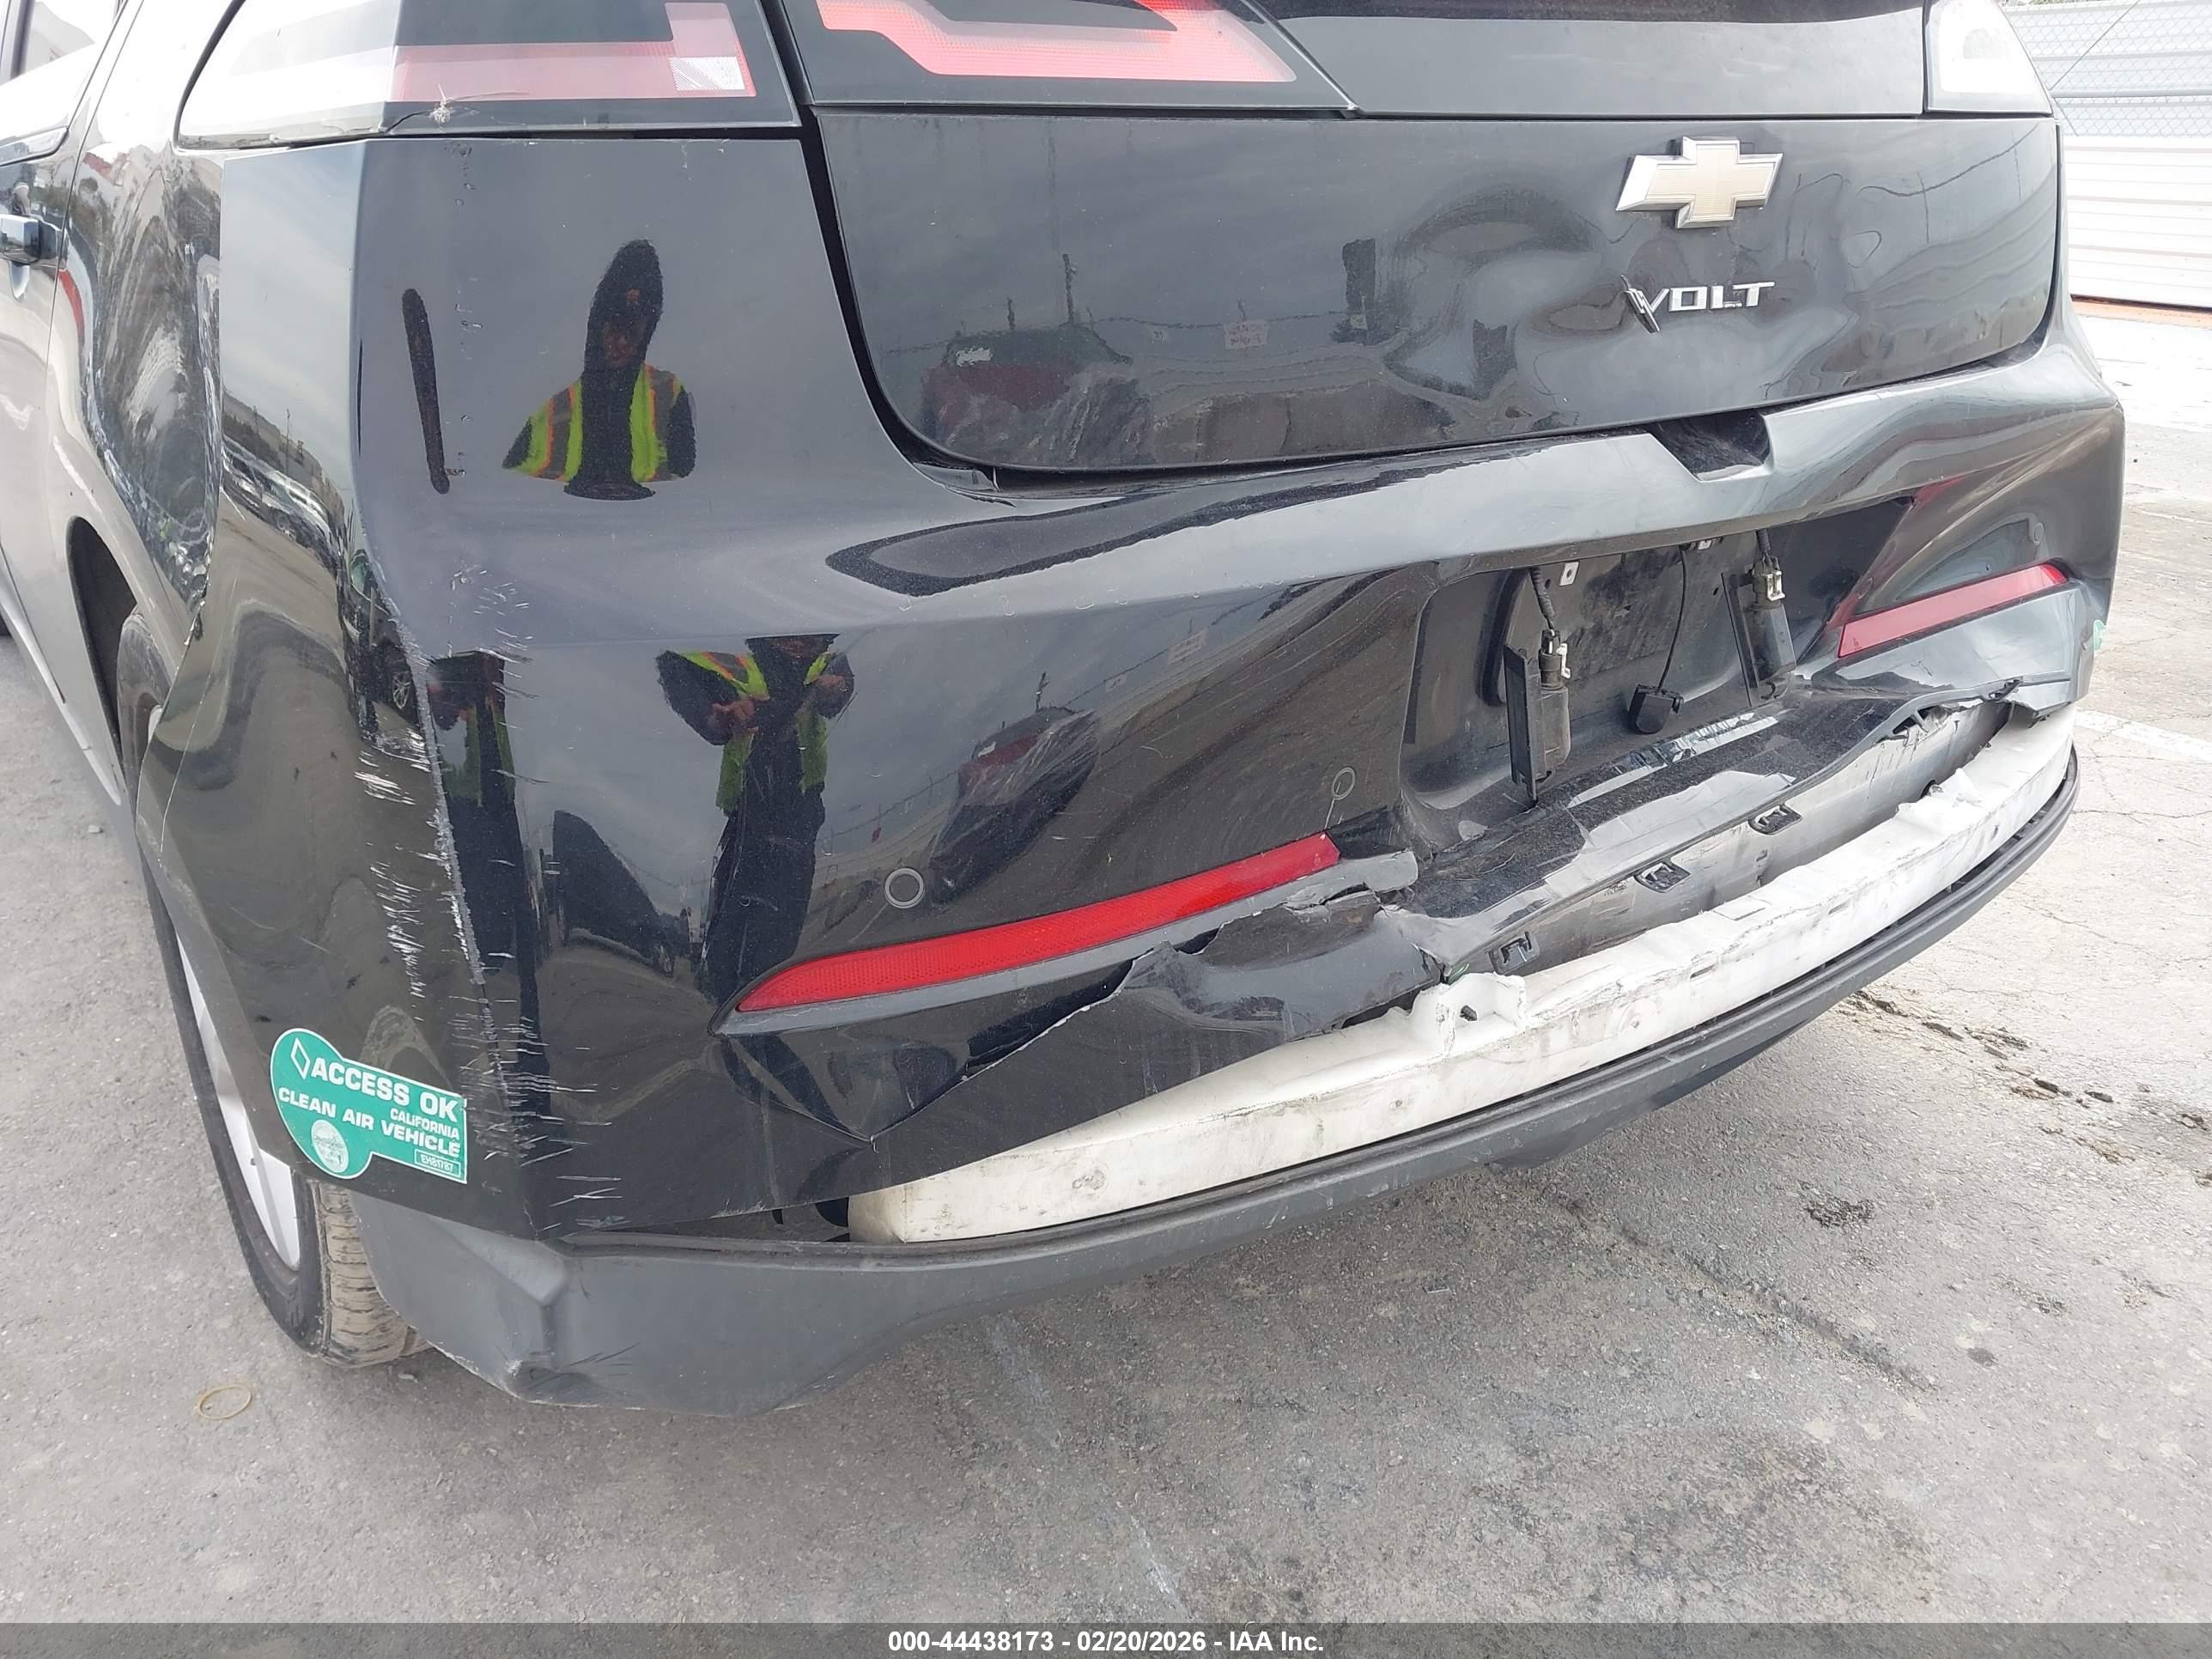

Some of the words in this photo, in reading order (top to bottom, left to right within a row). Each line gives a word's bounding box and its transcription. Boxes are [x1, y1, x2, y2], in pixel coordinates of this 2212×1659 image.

[1622, 278, 1775, 332] VOLT
[311, 1057, 410, 1106] ACCESS
[419, 1091, 459, 1122] OK
[278, 1087, 336, 1118] CLEAN
[343, 1109, 374, 1130] AIR
[381, 1120, 460, 1158] VEHICLE
[390, 1108, 459, 1139] CALIFORNIA
